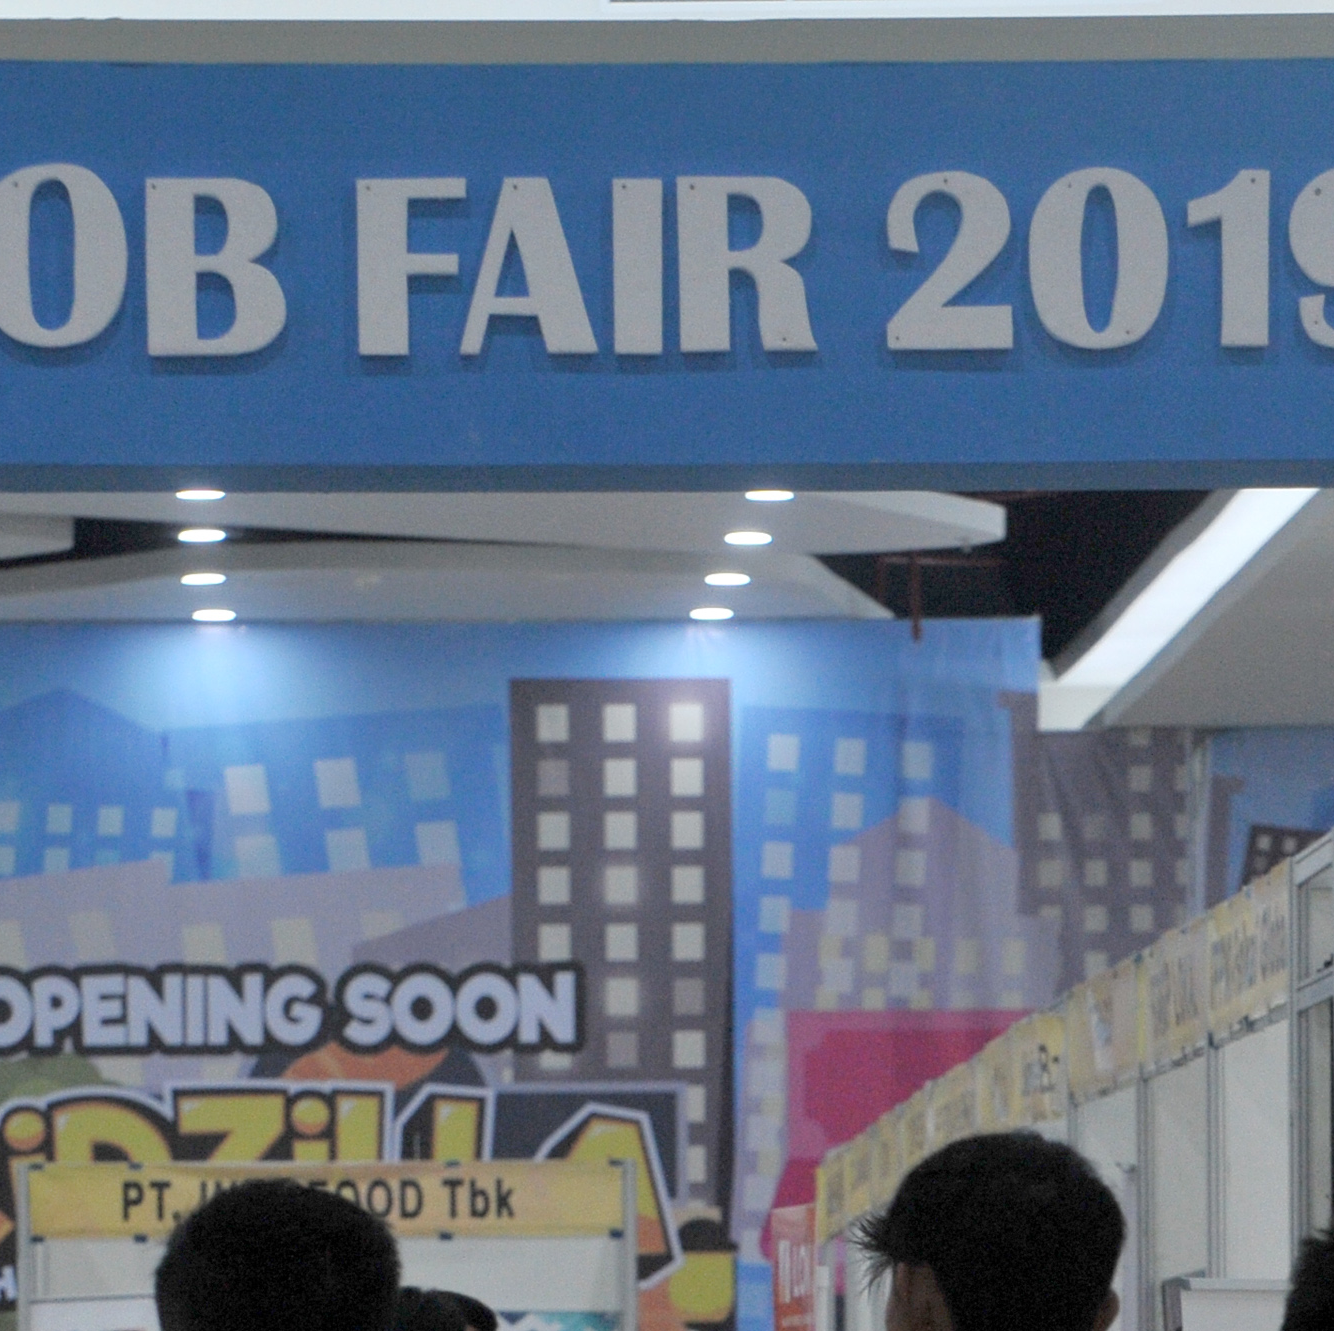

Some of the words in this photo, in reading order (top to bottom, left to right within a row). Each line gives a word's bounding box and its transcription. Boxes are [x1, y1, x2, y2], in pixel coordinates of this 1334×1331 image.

[355, 174, 819, 358] FAIR
[339, 968, 581, 1050] SOON
[122, 1180, 181, 1222] PT.
[442, 1176, 516, 1219] Tbk
